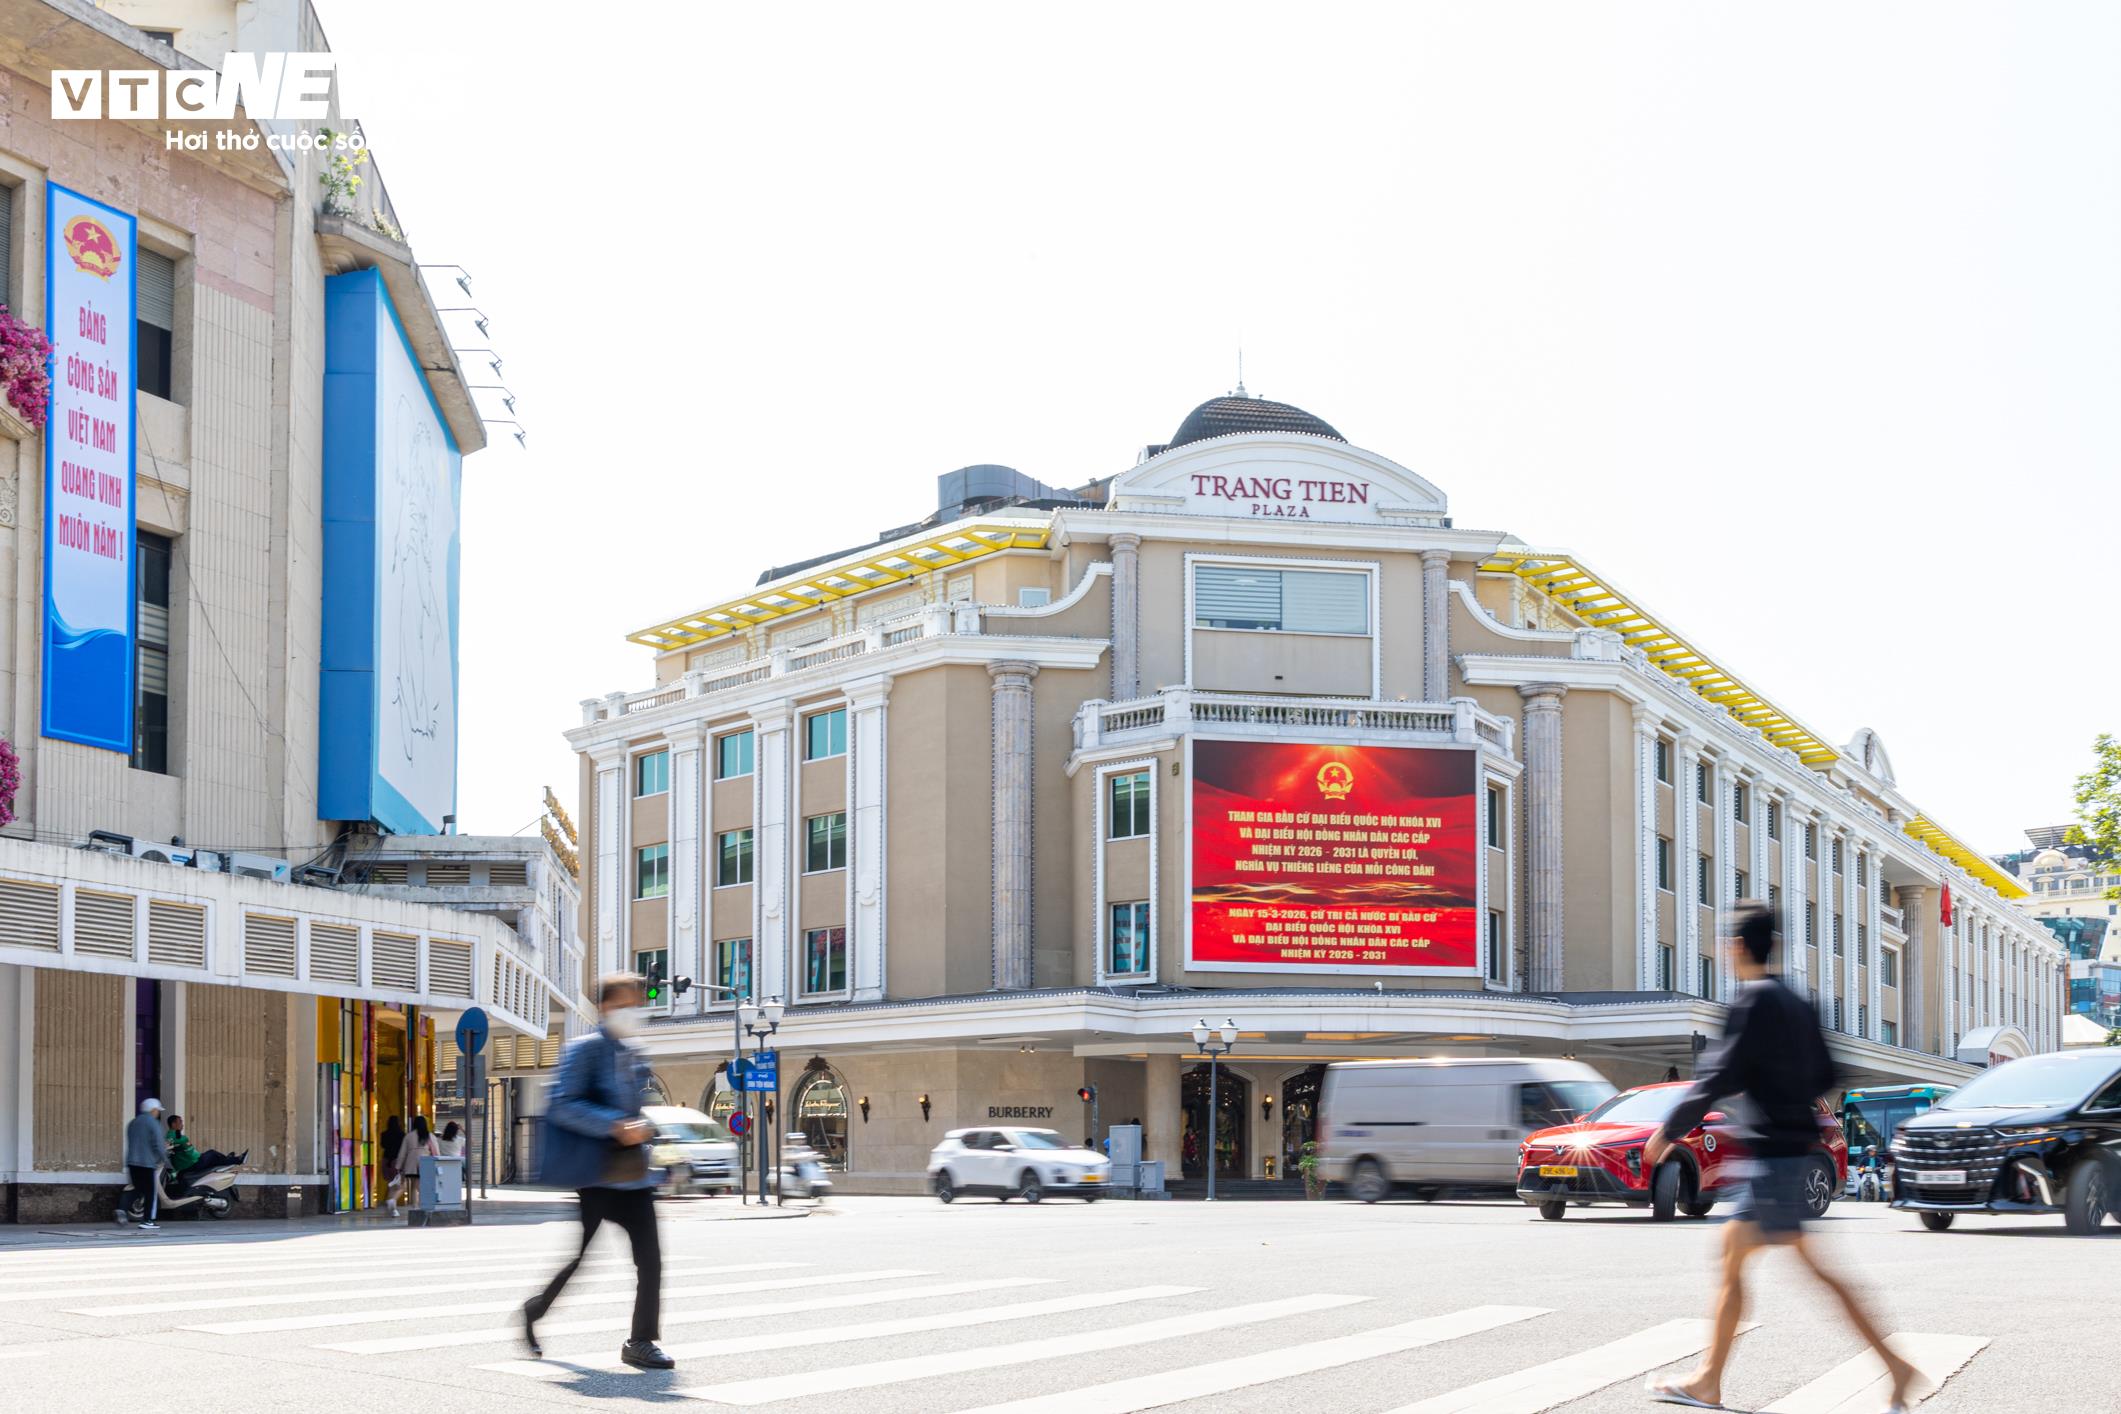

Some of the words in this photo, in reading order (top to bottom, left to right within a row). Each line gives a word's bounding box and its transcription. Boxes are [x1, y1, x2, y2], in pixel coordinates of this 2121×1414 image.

[79, 300, 107, 345] ĐẢNG
[67, 352, 94, 396] CỘNG
[98, 360, 117, 402] SẢN
[68, 406, 90, 450] VIỆT
[92, 418, 116, 454] NAM
[61, 461, 95, 500] QUANG
[98, 472, 122, 508] VINH
[1191, 474, 1291, 501] TRANG
[1298, 479, 1369, 504] TIEN
[1252, 503, 1310, 518] PLAZA
[59, 512, 90, 553] MUÔN
[93, 521, 117, 560] NĂM
[1228, 811, 1254, 822] THAM
[1256, 812, 1273, 823] GIA
[1426, 817, 1442, 828] XVI
[1298, 847, 1323, 857] 2026
[1333, 847, 1356, 858] 2031
[1327, 911, 1342, 920] TRI
[1385, 925, 1401, 934] XVI
[1329, 950, 1354, 959] 2026
[1362, 951, 1386, 960] 2031
[988, 1106, 1054, 1118] BURBERRY
